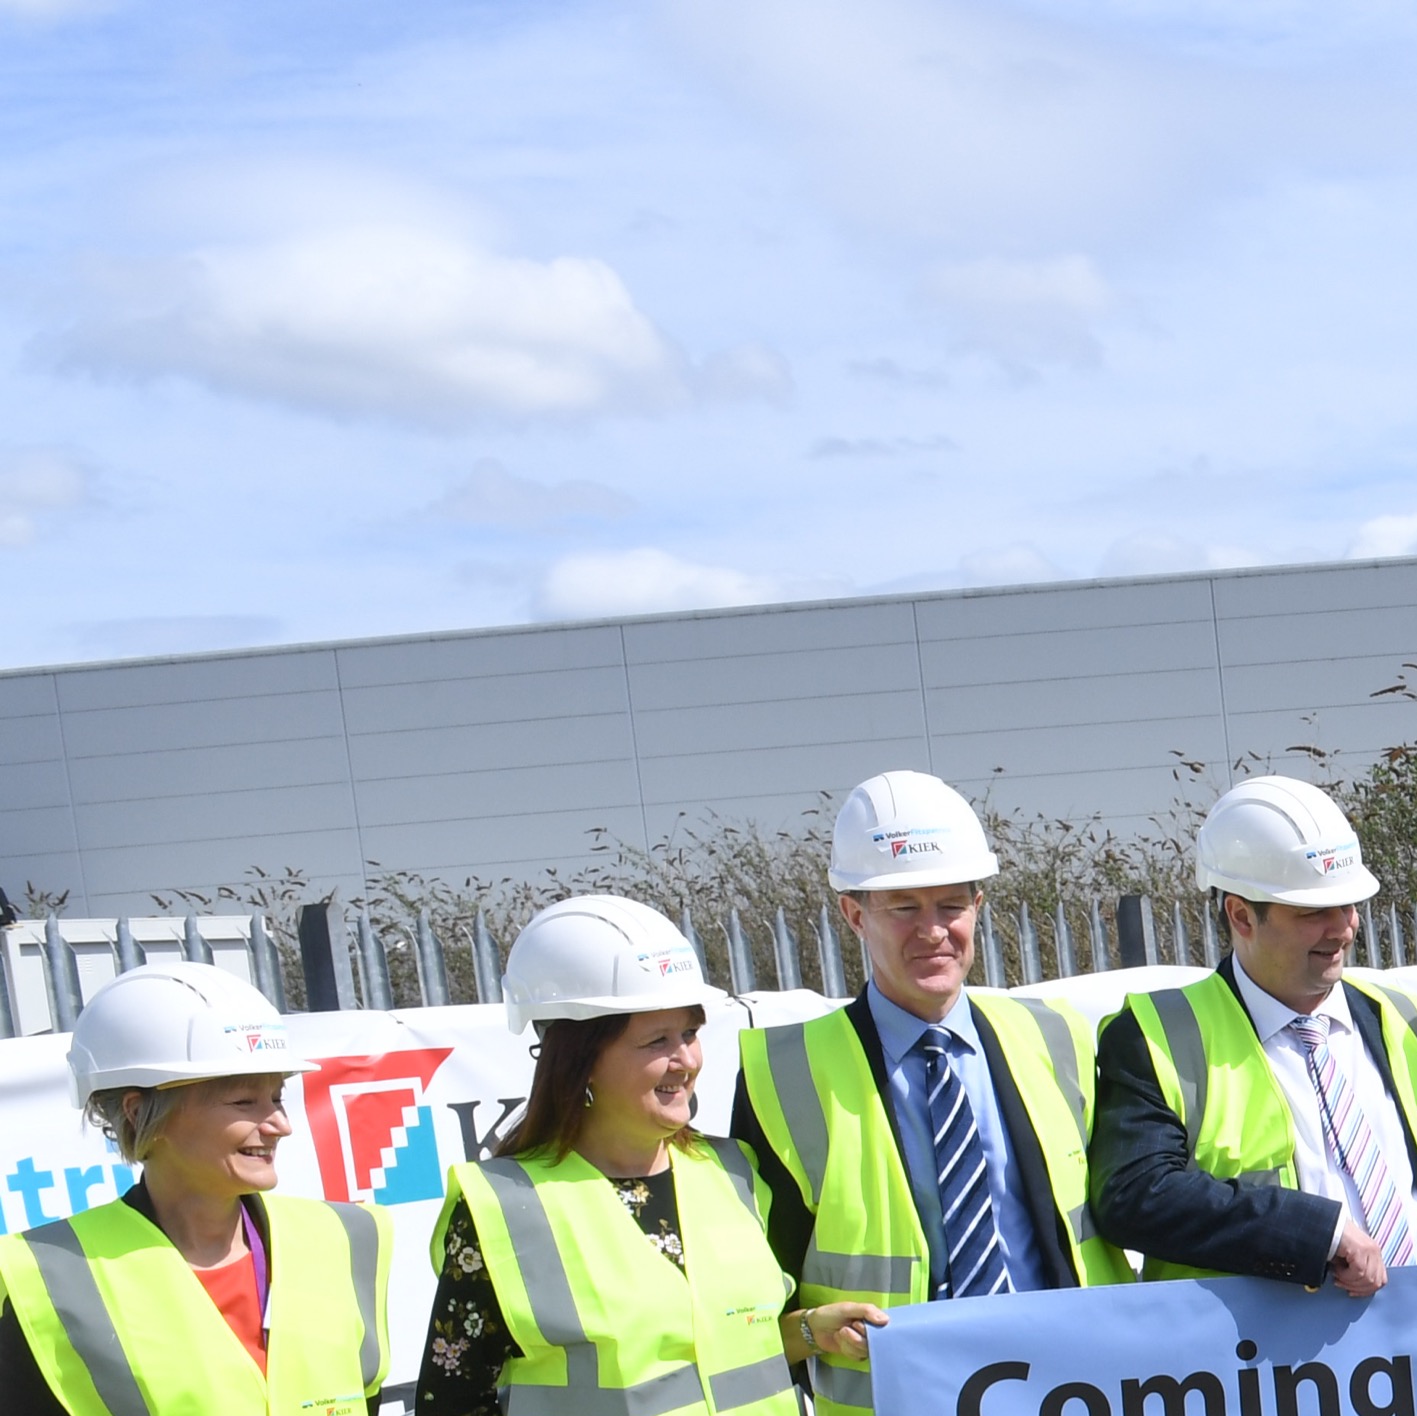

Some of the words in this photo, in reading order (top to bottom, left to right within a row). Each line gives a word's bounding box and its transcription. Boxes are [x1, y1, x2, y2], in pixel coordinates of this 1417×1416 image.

[908, 842, 941, 854] KIER
[1335, 856, 1355, 870] KIER
[263, 1038, 287, 1050] KIER
